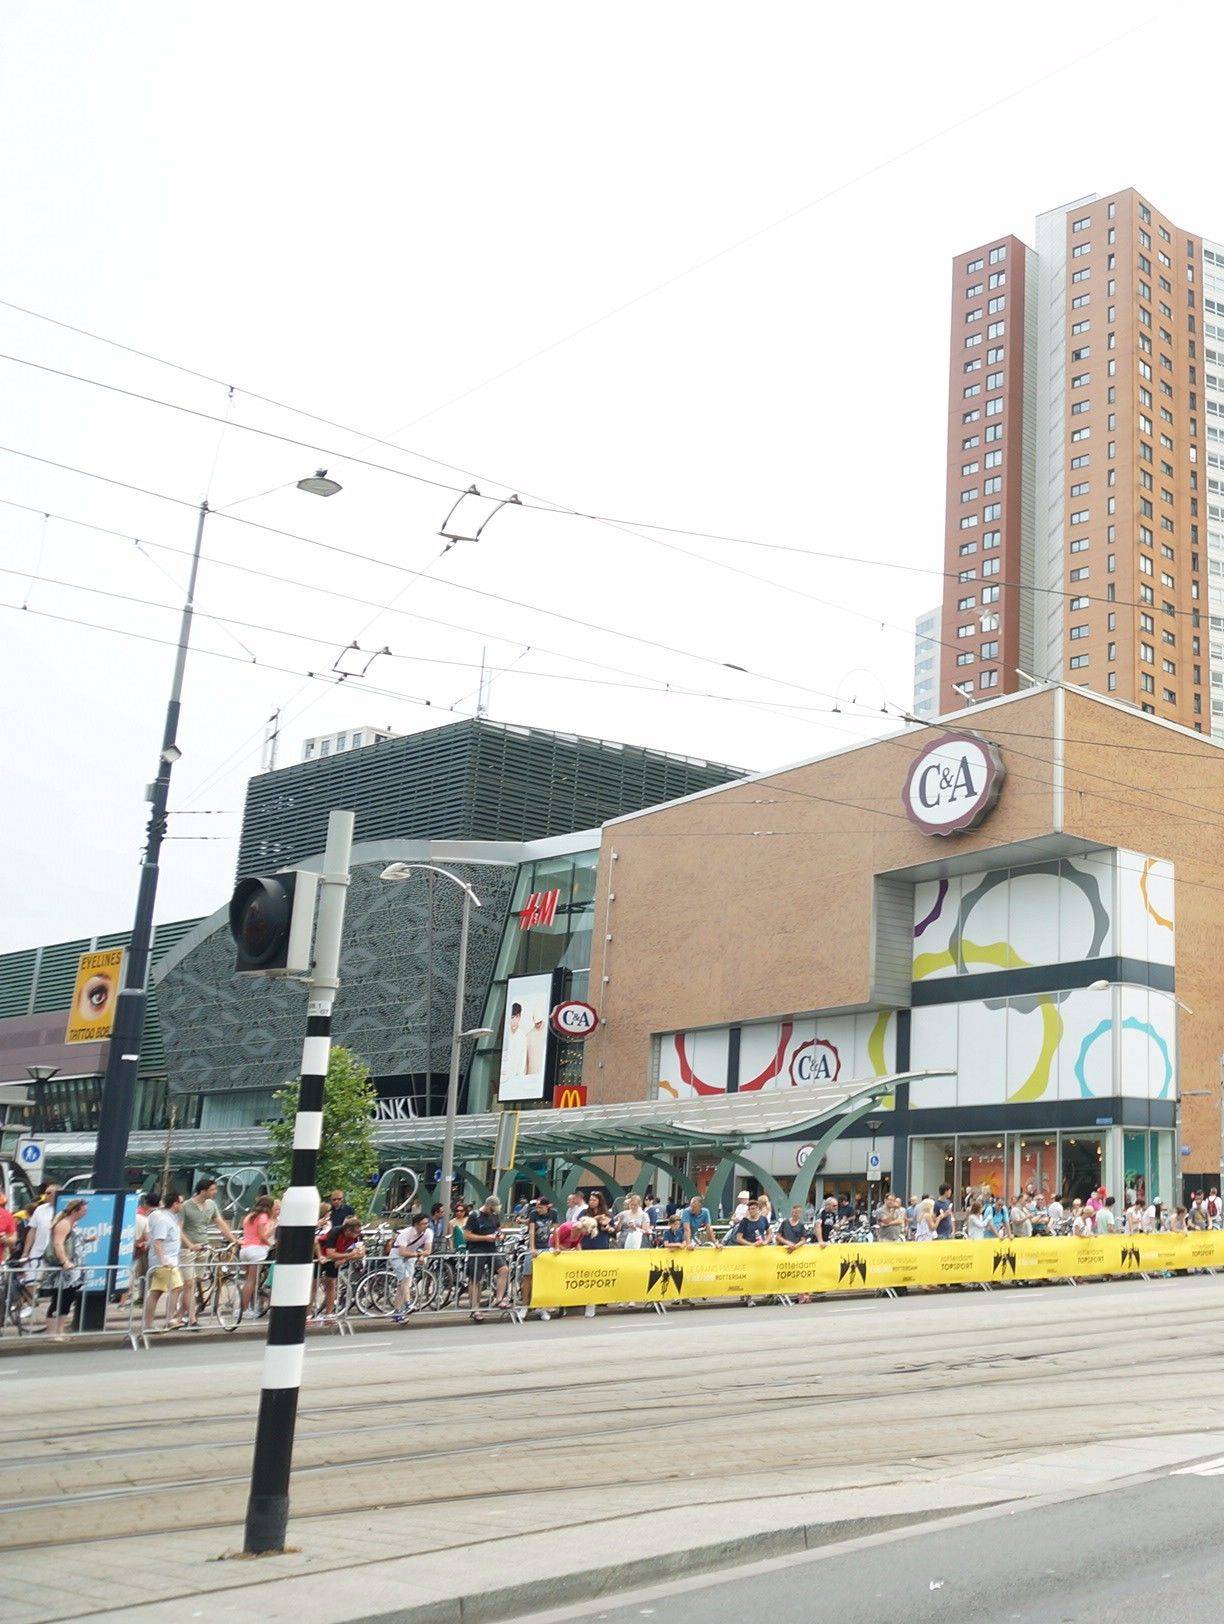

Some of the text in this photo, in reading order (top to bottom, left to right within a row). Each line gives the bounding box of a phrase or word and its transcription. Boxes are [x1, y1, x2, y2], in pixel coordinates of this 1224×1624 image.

[918, 755, 978, 809] C&A
[519, 888, 561, 931] H&M
[81, 951, 121, 970] EYELINES
[562, 1009, 591, 1027] C&A
[798, 1053, 832, 1080] C&A
[564, 1268, 618, 1279] rotterdam
[776, 1261, 816, 1270] rotterdam
[776, 1269, 816, 1280] TOPSPORT
[564, 1278, 617, 1290] TOPSPORT
